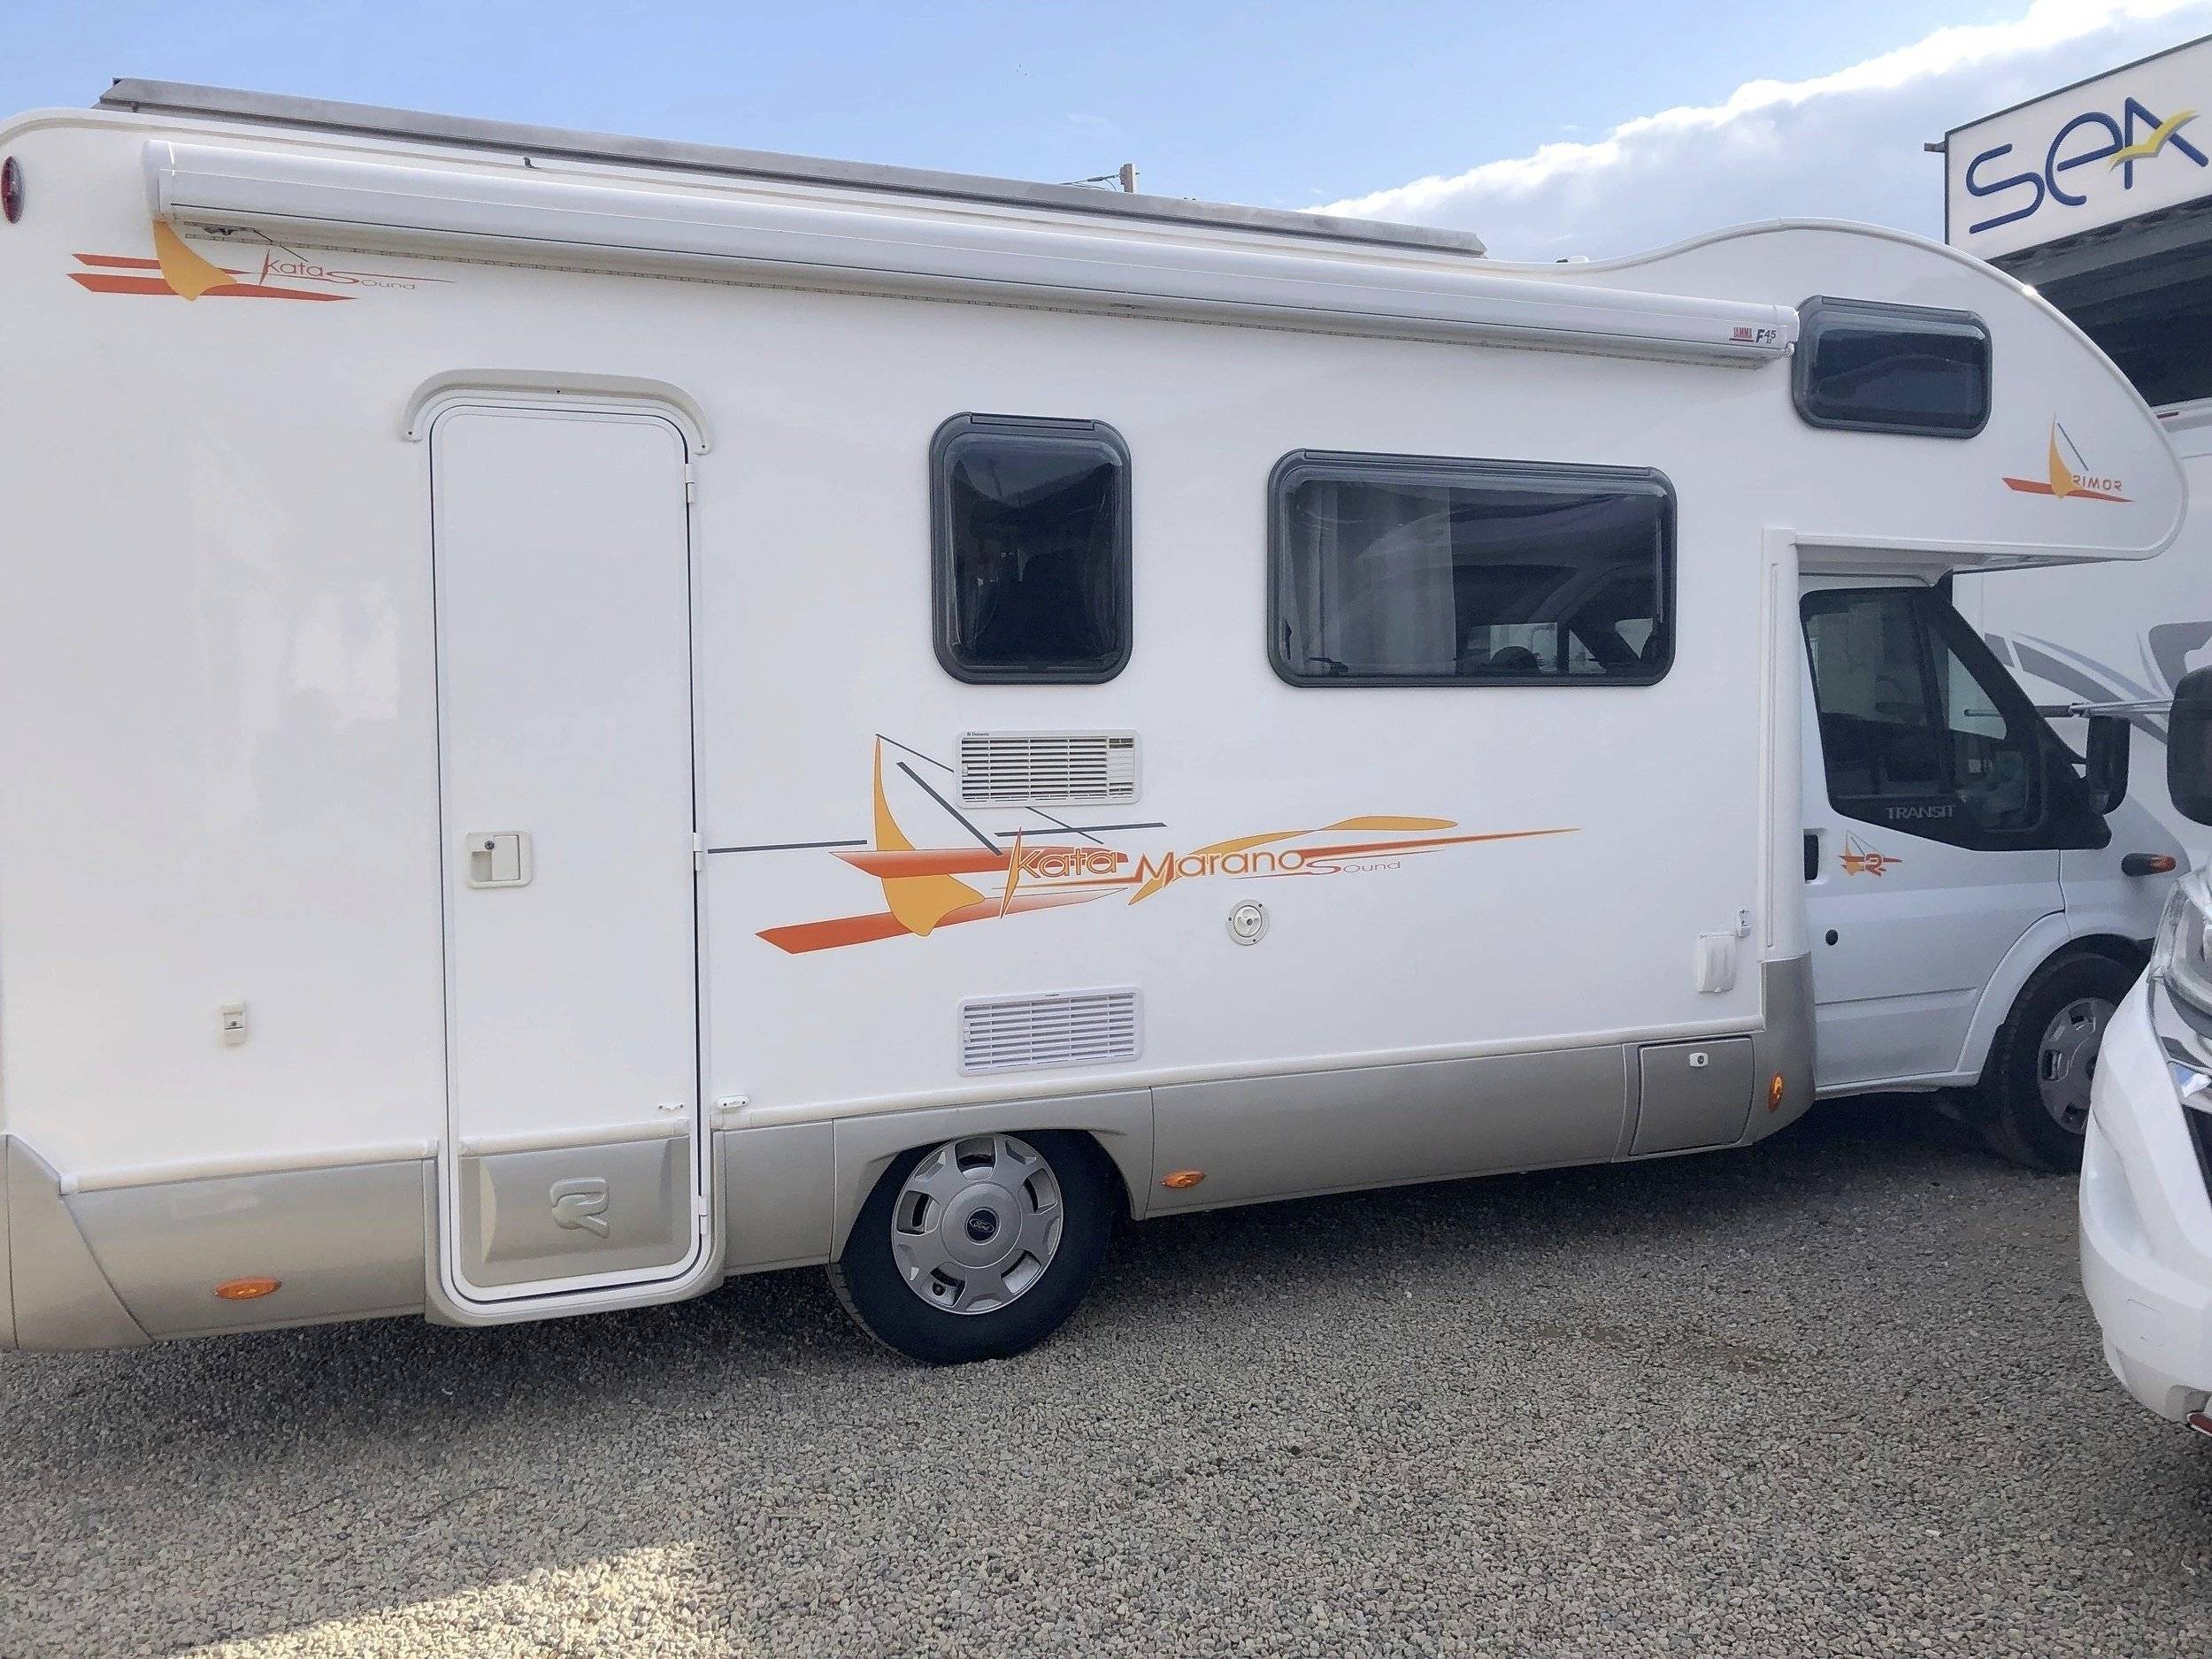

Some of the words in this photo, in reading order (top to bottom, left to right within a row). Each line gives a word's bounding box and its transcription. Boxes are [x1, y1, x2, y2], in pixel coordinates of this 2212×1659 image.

[2073, 474, 2123, 491] RIMOR
[1886, 805, 1955, 819] TRANSIT
[1133, 848, 1304, 888] Marano
